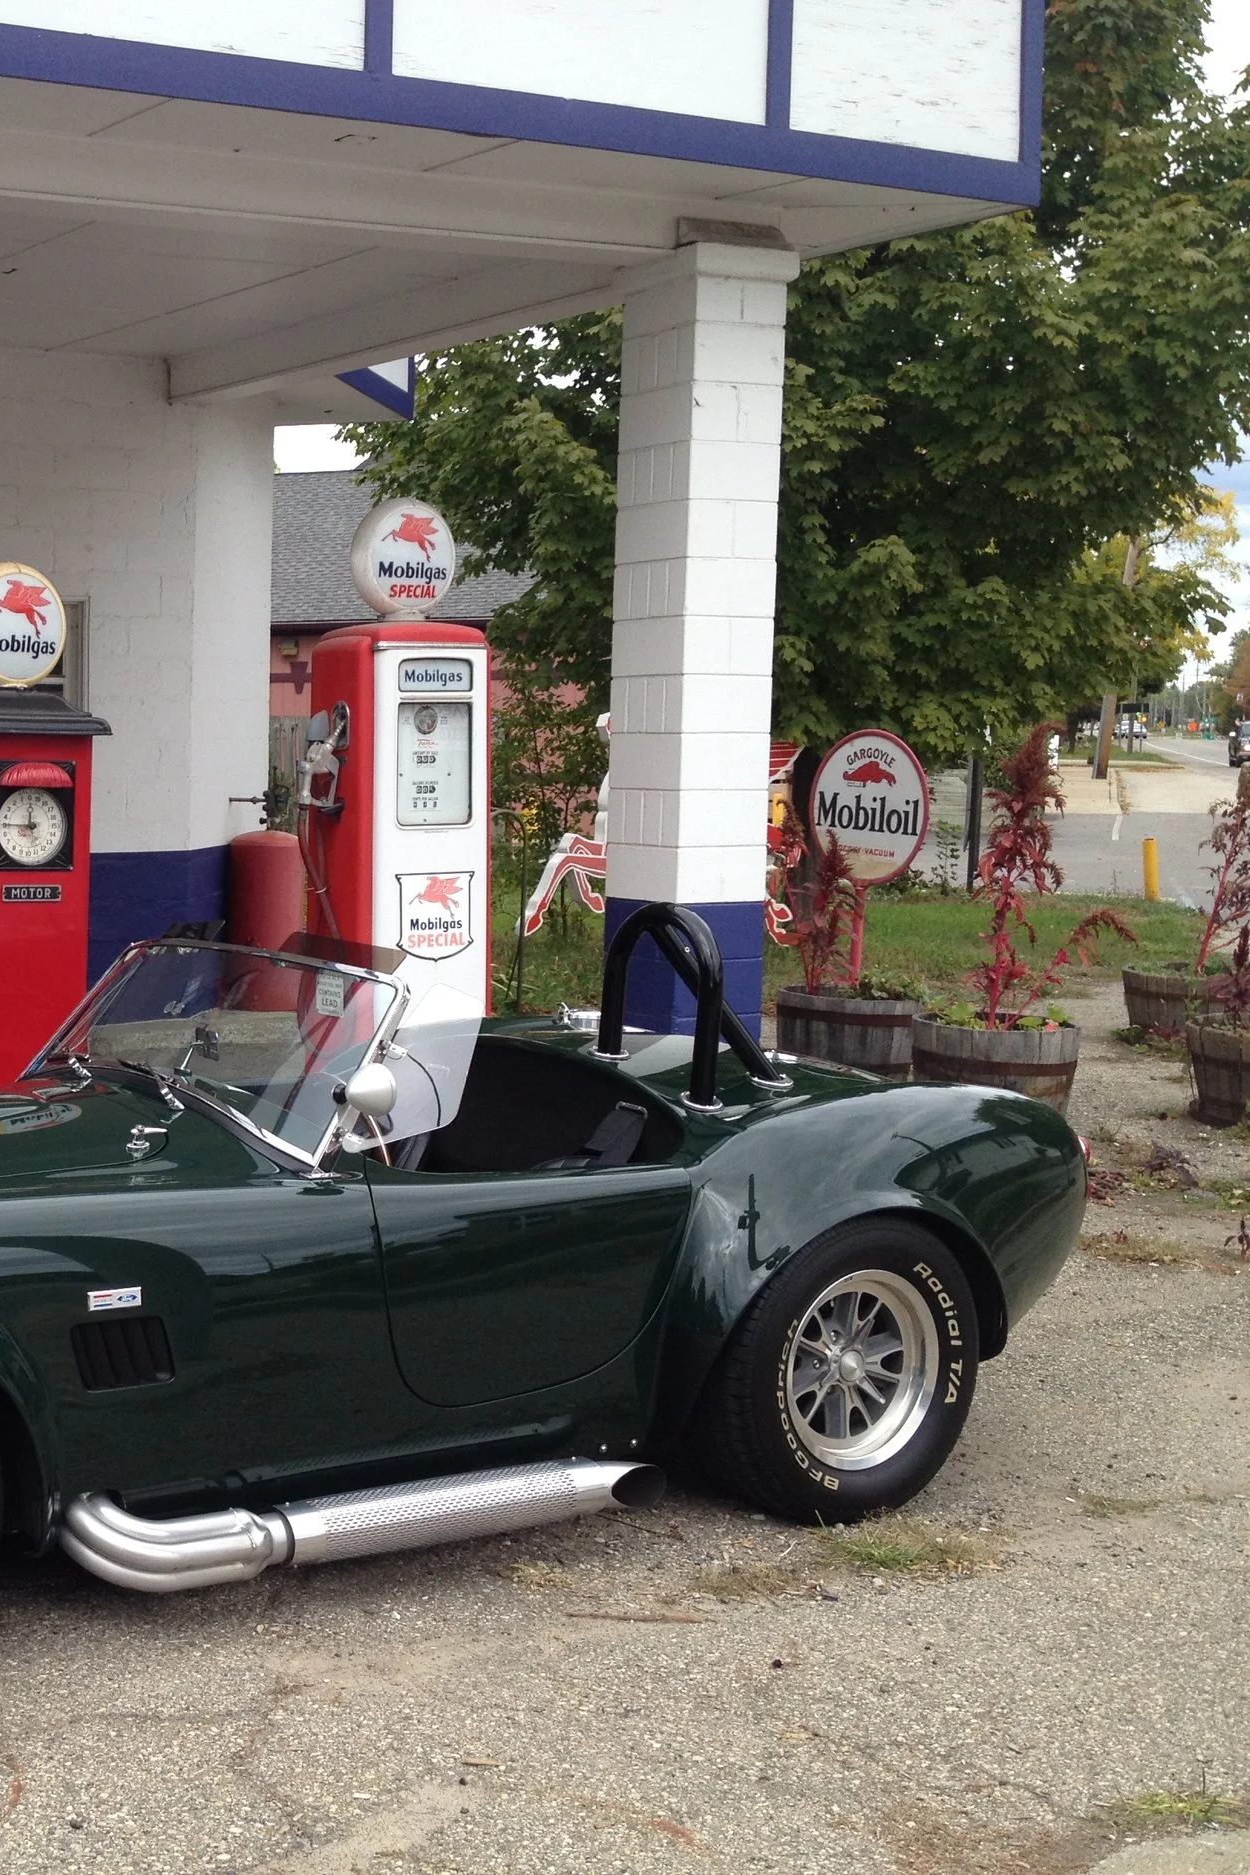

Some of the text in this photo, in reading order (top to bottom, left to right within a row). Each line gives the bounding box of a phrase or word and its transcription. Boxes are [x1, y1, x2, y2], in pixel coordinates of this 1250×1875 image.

[378, 561, 448, 585] Mobilgas
[389, 583, 437, 599] SPECIAL
[403, 669, 463, 687] Mobilgas
[846, 747, 897, 769] GARGOYLE
[815, 790, 920, 837] Mobiloil
[864, 847, 896, 859] VACUUM
[11, 888, 52, 899] MOTOR
[410, 917, 463, 933] Mobilgas
[407, 932, 466, 949] SPECIAL
[321, 998, 338, 1008] LEAD
[913, 1262, 963, 1404] Radial T/A
